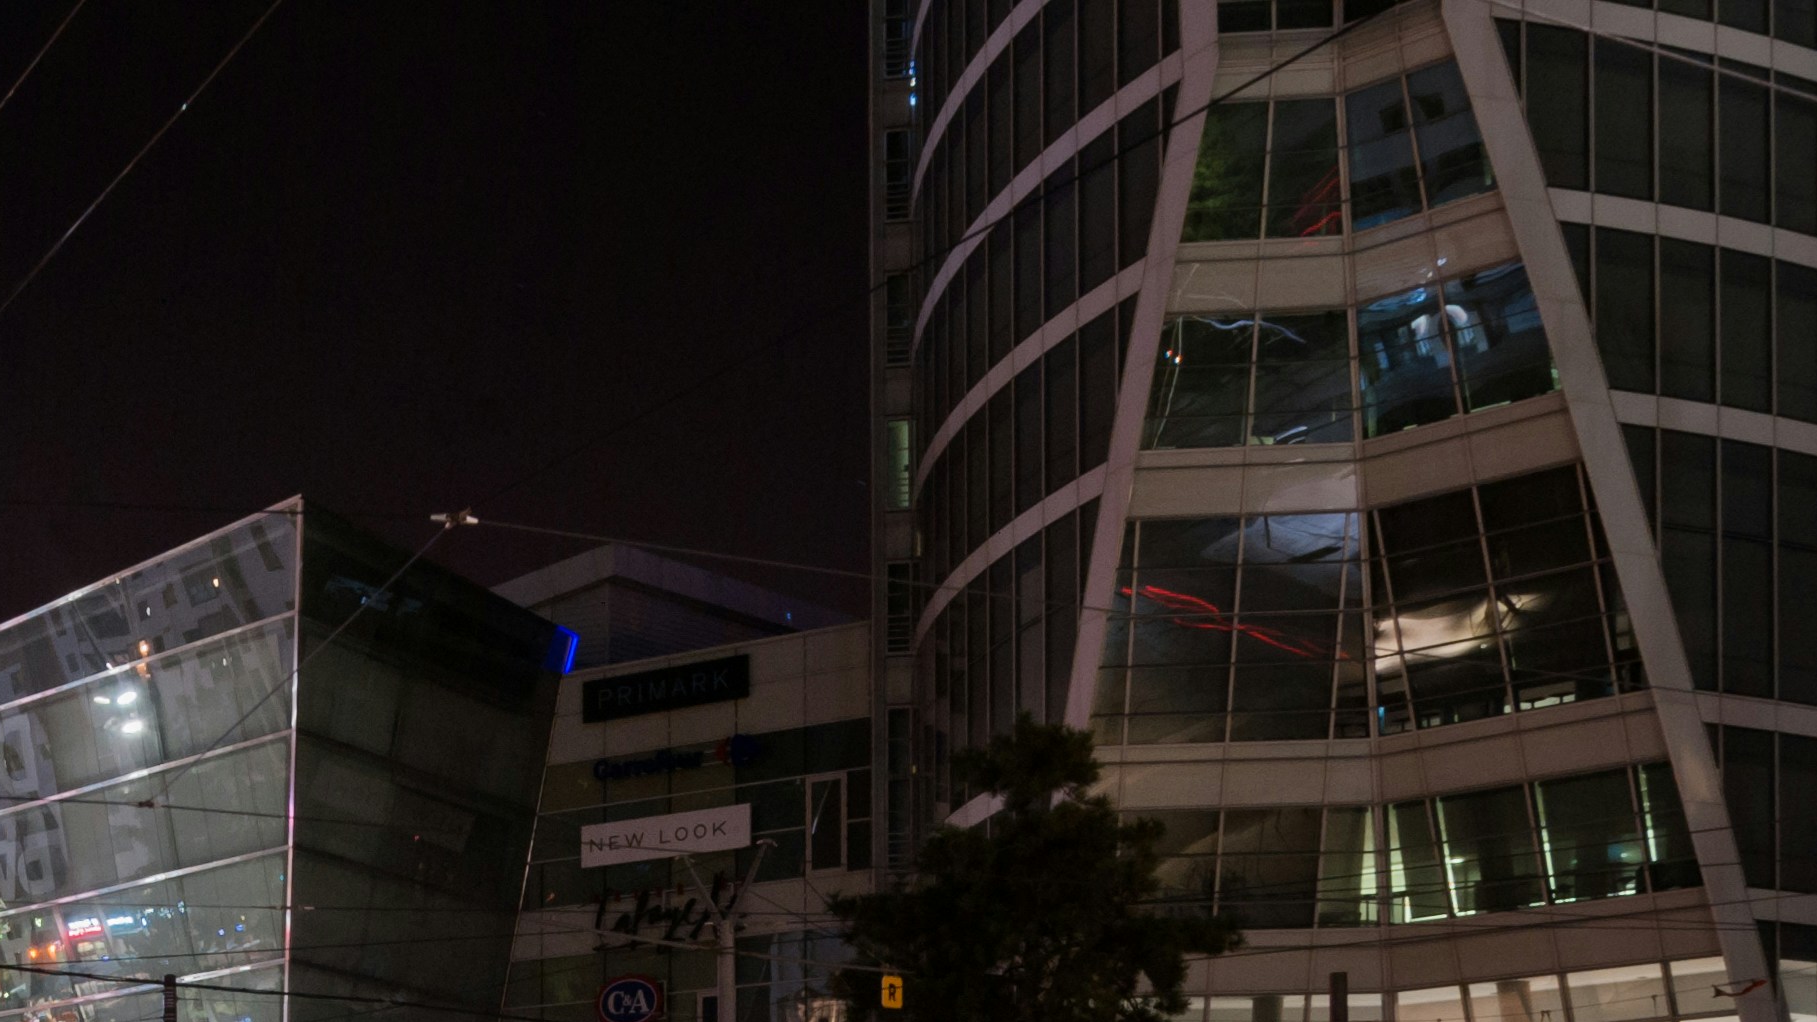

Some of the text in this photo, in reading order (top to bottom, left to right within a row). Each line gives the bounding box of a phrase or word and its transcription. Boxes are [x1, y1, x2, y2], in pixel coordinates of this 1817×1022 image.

[597, 668, 730, 710] PRIMARK
[589, 820, 728, 853] NEW LOOK
[607, 989, 650, 1015] C&A
